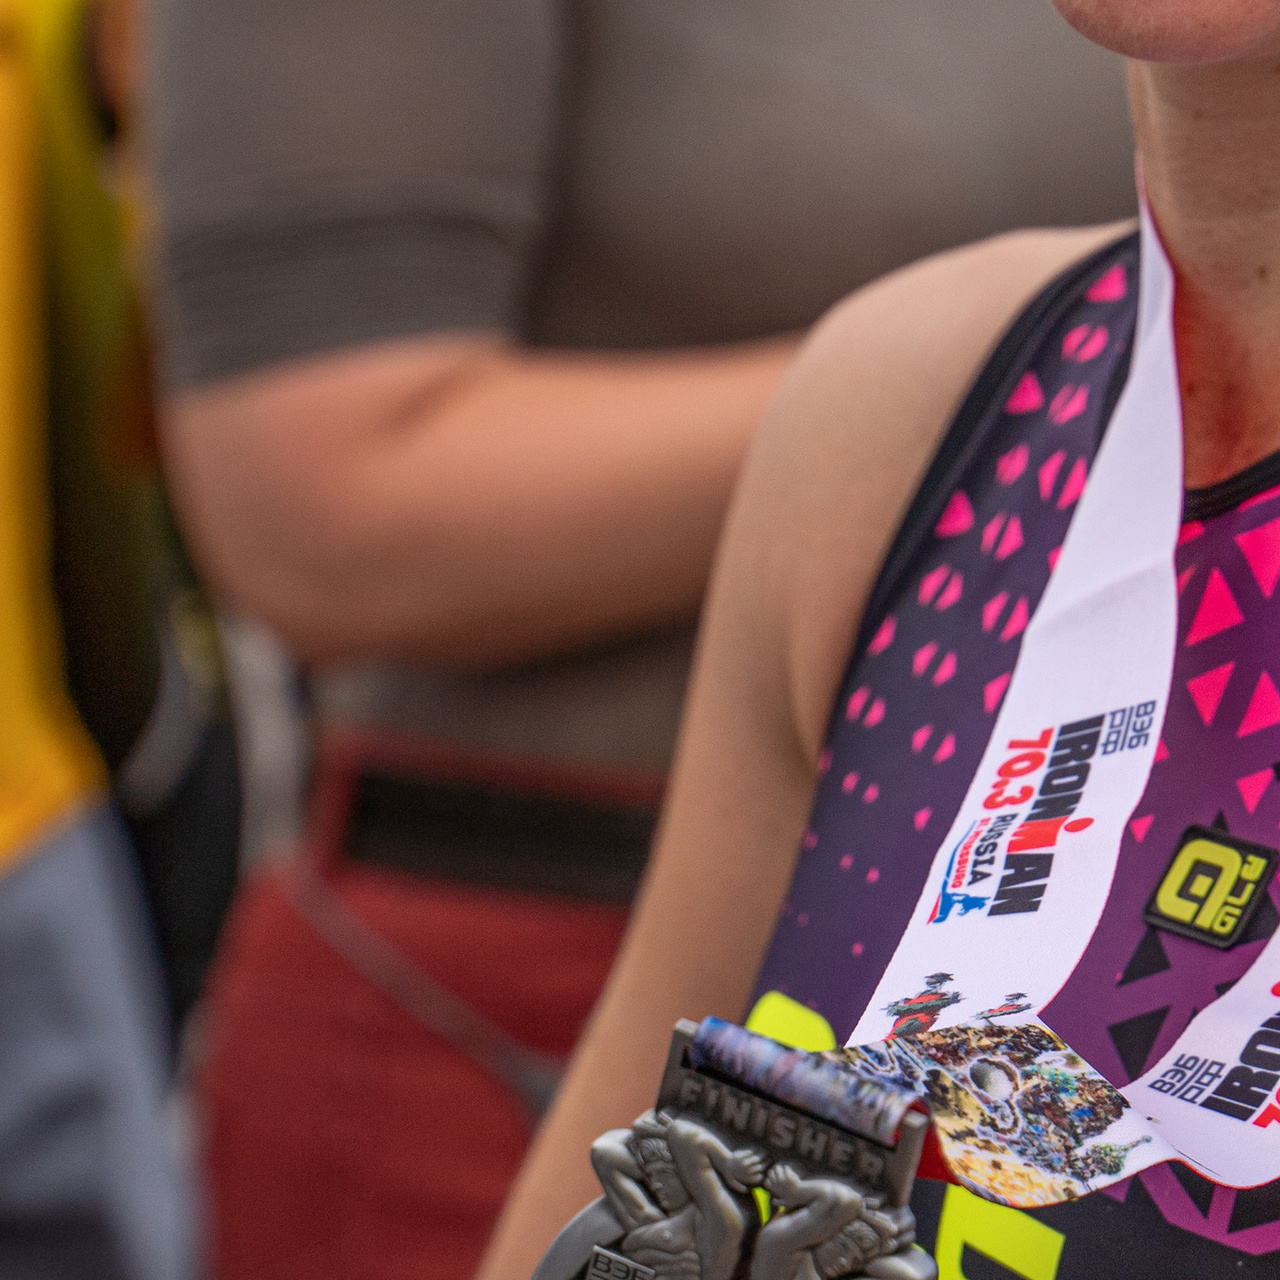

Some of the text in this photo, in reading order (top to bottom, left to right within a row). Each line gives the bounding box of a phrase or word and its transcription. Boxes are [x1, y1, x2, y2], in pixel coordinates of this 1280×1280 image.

[983, 726, 1055, 810] 70.3
[987, 713, 1106, 917] IRONMAN
[967, 813, 1019, 886] RUSSIA
[680, 1077, 887, 1185] FINISHER
